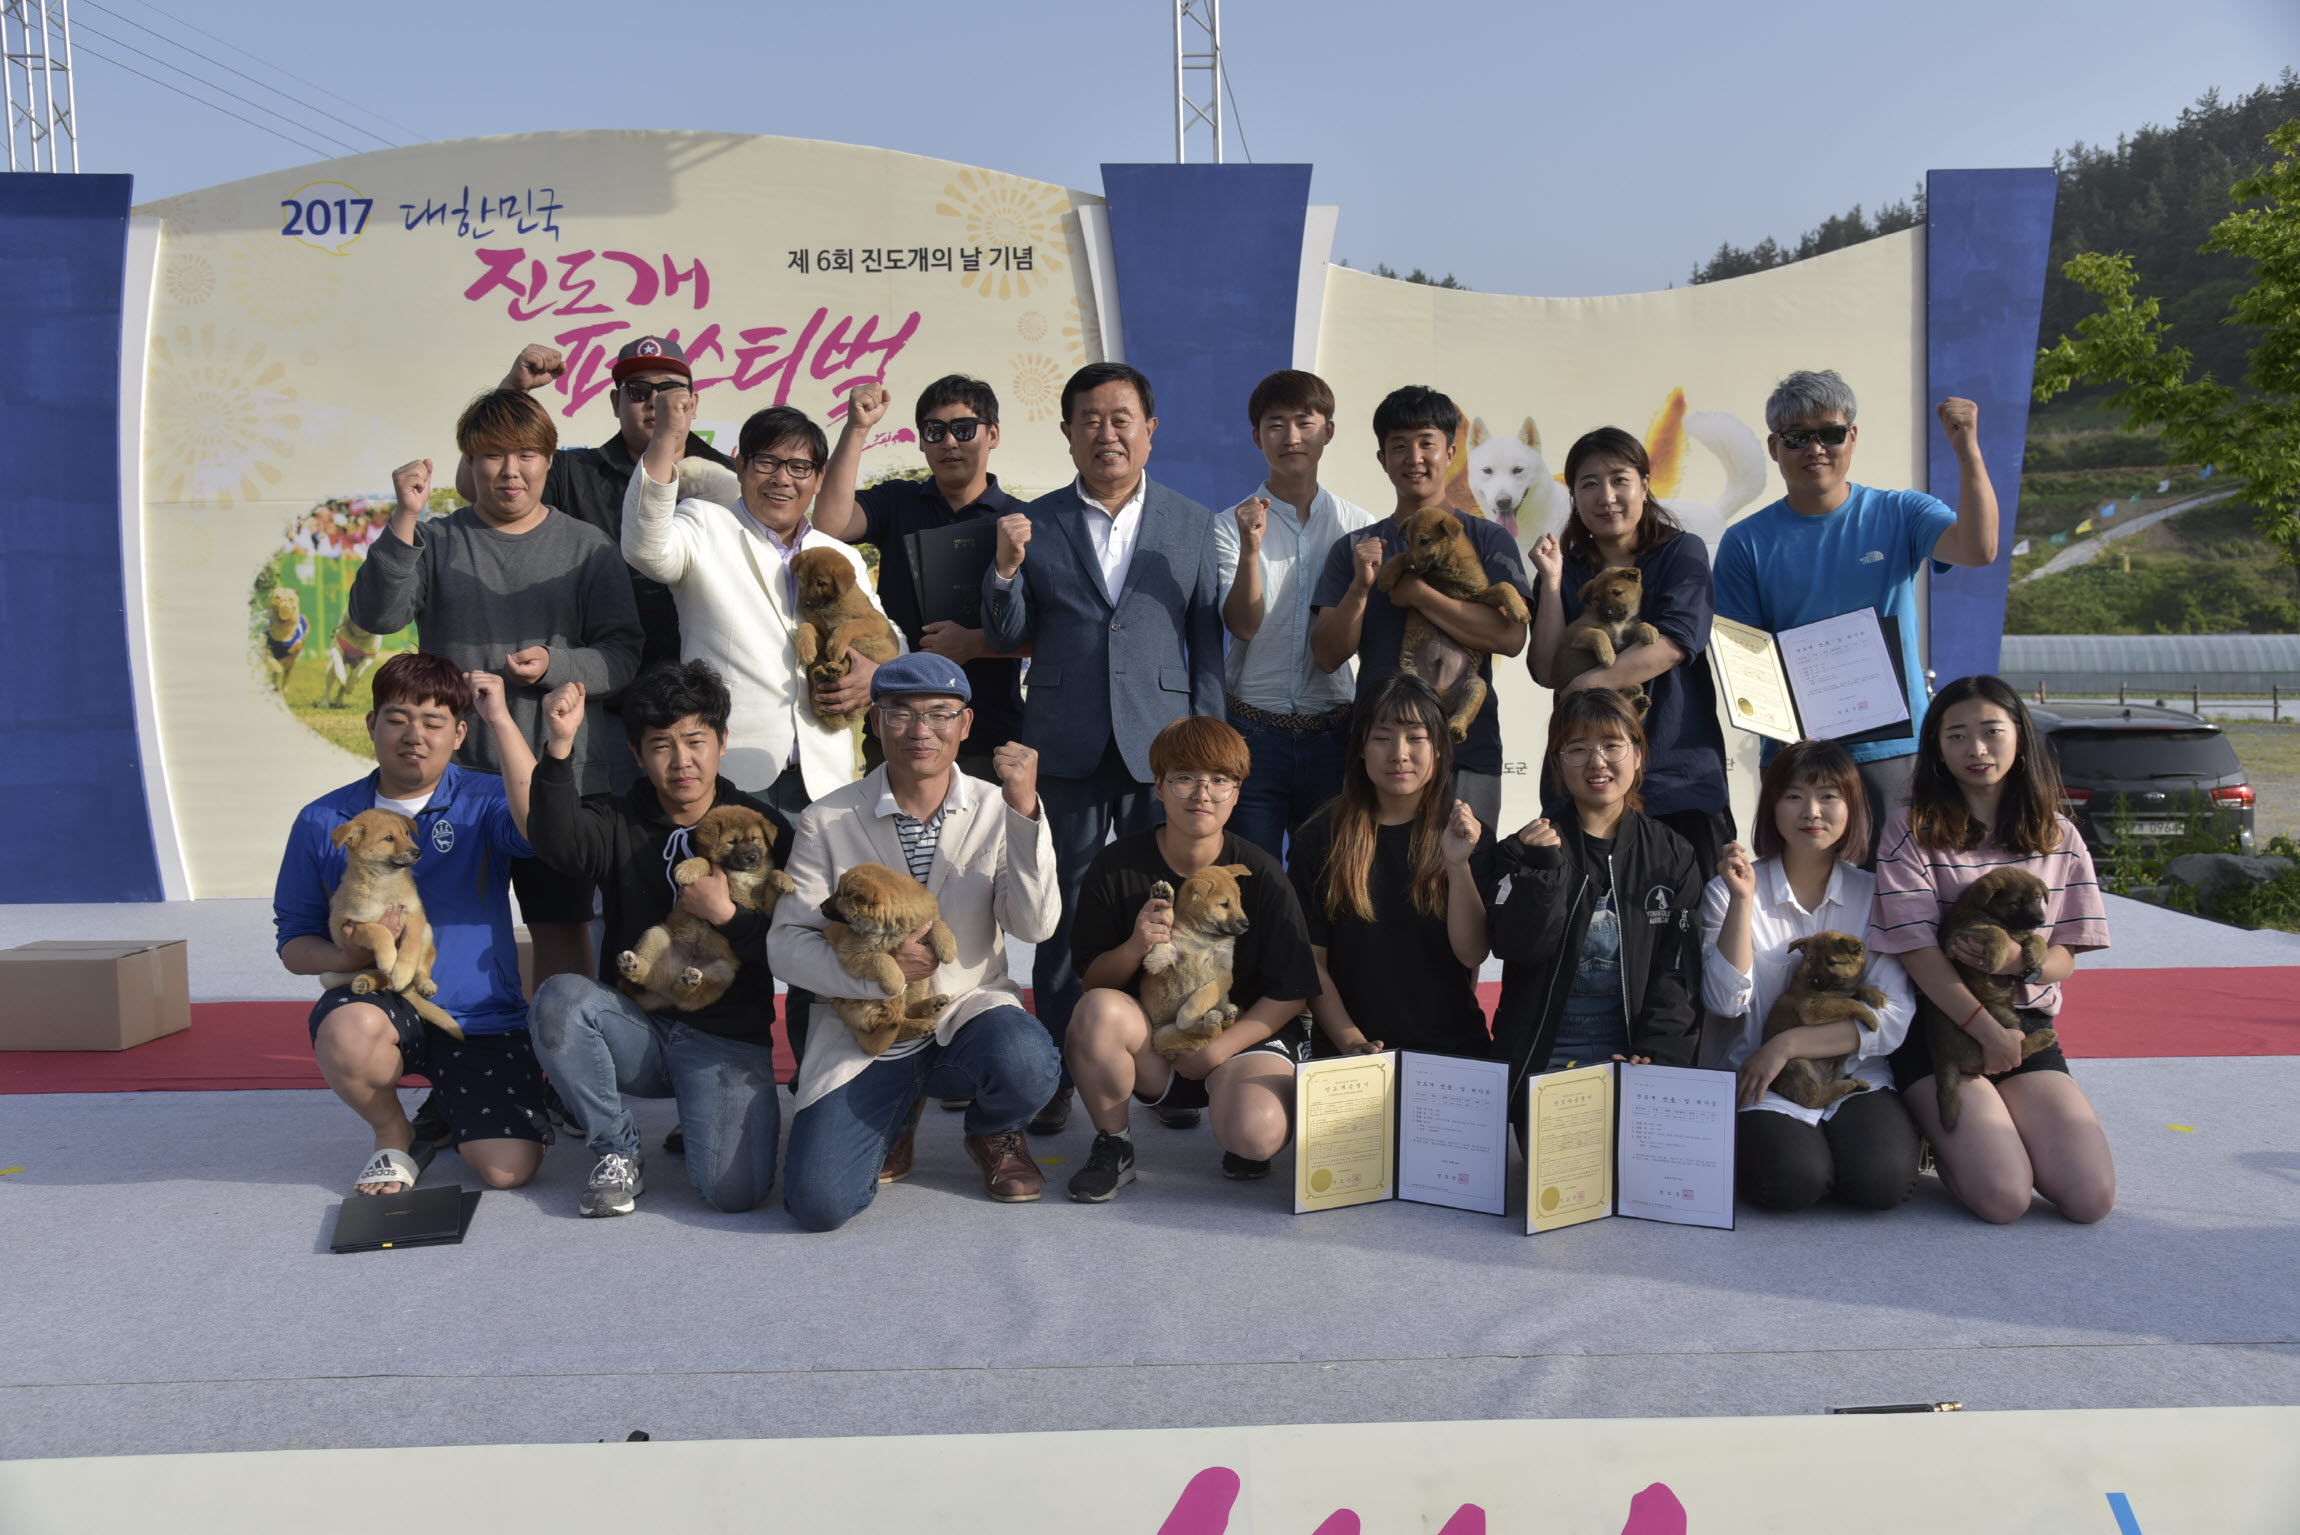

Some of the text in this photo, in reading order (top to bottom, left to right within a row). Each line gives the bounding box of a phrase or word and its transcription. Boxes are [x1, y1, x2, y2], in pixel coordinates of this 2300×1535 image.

[281, 185, 565, 243] 2017 대한민국
[787, 245, 1034, 274] 제 6회 진도개의 날 기념
[463, 247, 711, 322] 진도개
[1502, 761, 1529, 776] 도군
[361, 1167, 398, 1179] adidas
